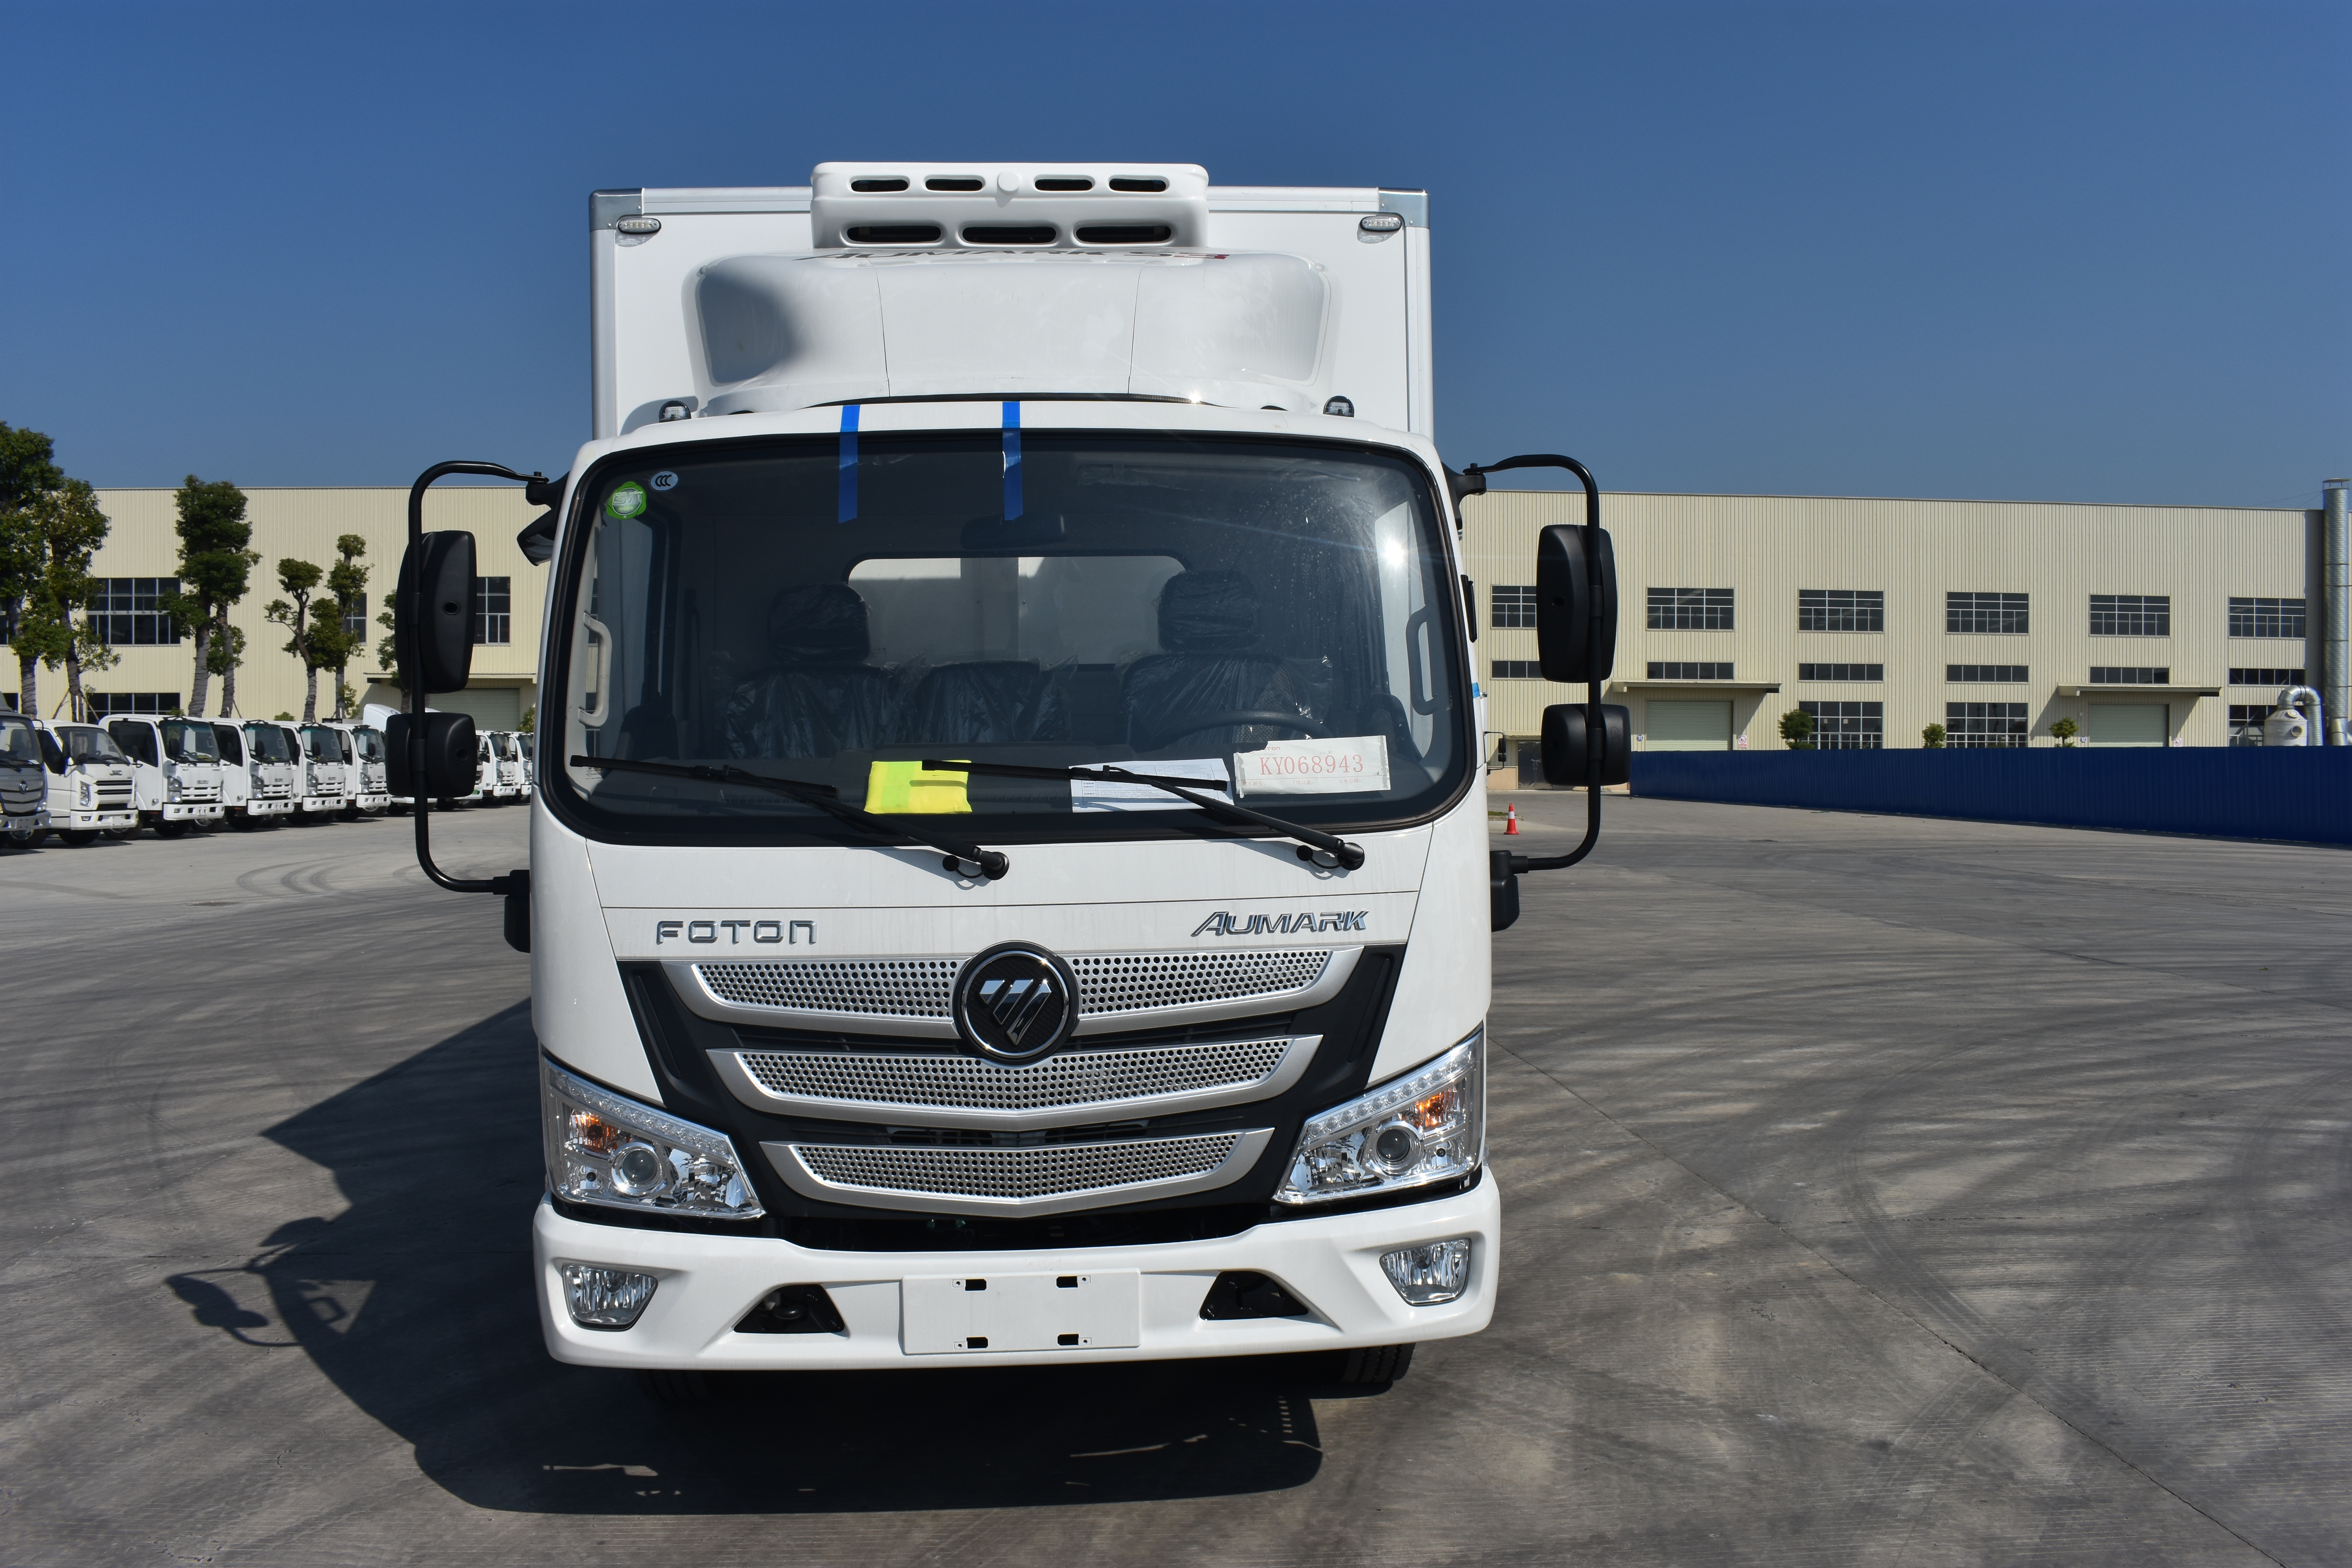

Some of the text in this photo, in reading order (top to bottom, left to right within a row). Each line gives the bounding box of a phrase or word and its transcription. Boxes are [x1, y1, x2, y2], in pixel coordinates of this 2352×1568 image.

[655, 474, 672, 487] CCC
[1259, 754, 1363, 775] KY068943
[656, 920, 818, 945] FOTON
[1190, 910, 1370, 937] AUMARK
